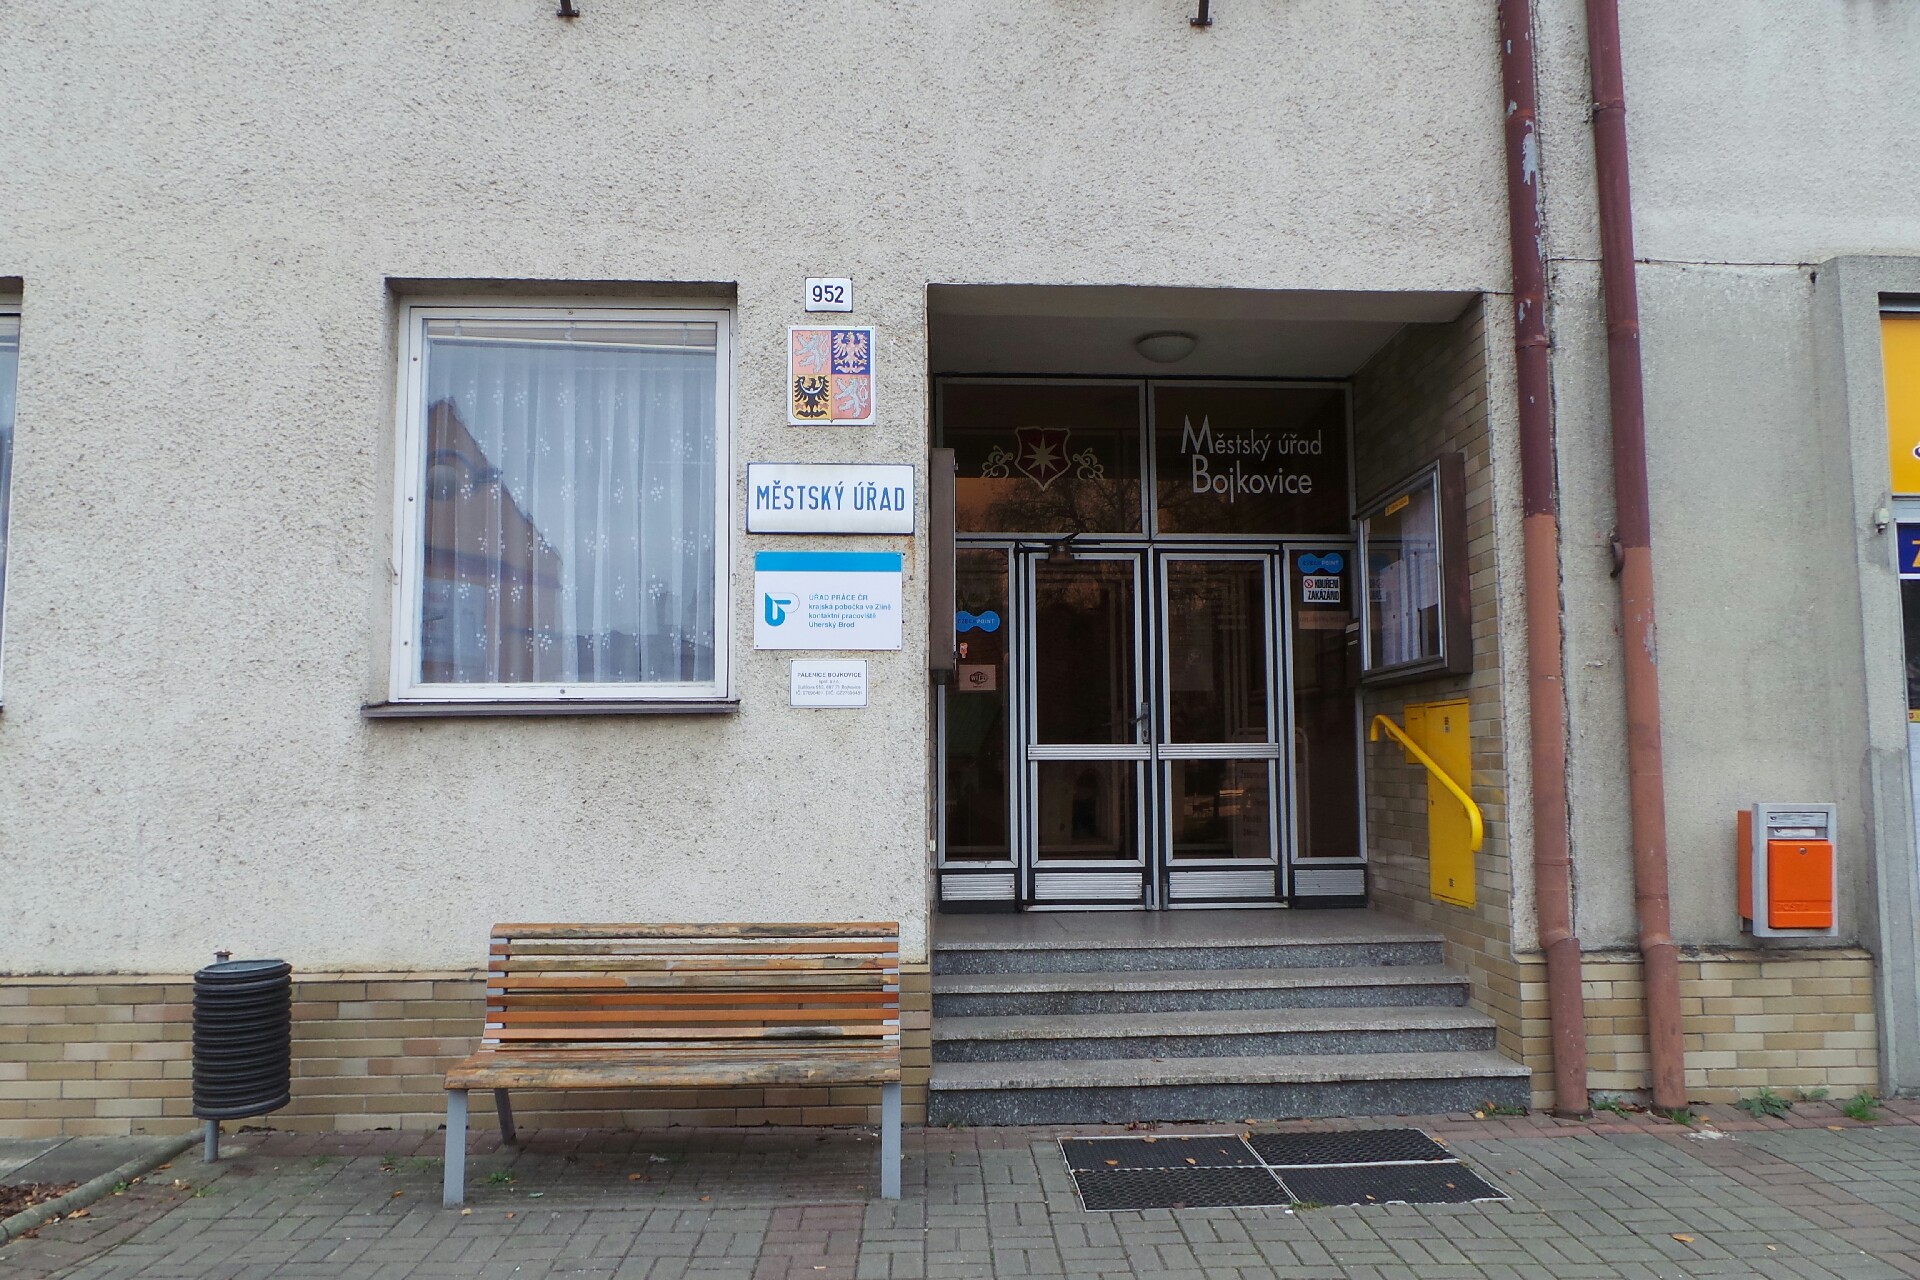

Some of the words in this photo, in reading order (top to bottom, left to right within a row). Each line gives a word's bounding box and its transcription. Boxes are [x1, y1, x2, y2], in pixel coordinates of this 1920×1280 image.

[812, 285, 844, 304] 952
[1180, 413, 1272, 462] Městský
[1278, 428, 1322, 455] úřad
[1192, 454, 1313, 503] Bojkovice
[756, 479, 844, 510] MĚSTSKÝ
[853, 481, 905, 512] ÚŘAD
[808, 592, 830, 601] ÚŘAD
[831, 592, 856, 601] PRÁCE
[857, 592, 868, 601] ČR
[1307, 588, 1340, 601] ZAKÁZÁNO
[808, 603, 833, 612] krajská
[834, 603, 864, 612] pobočka
[874, 603, 892, 611] Zlíně
[808, 612, 840, 620] kontaktní
[841, 612, 877, 621] pracoviště
[808, 621, 836, 629] Uherský
